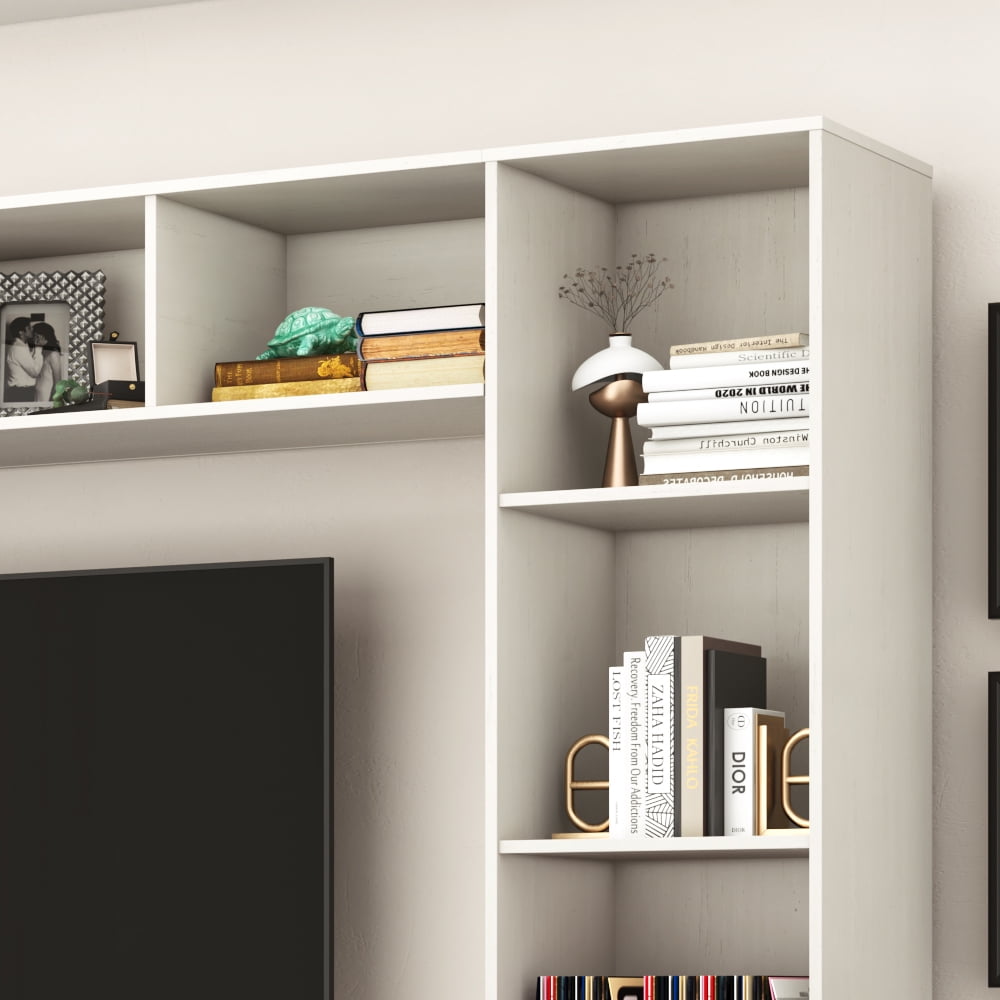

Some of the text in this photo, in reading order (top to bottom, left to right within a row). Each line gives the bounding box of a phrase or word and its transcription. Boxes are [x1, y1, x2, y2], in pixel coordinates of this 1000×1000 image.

[738, 350, 797, 361] Scientific
[749, 370, 770, 378] BOOK
[715, 388, 743, 398] 2020
[745, 387, 756, 396] IN
[759, 385, 797, 395] WORLD
[612, 672, 621, 751] LOST FISH
[631, 703, 642, 741] Freedom
[652, 685, 664, 785] ZAHA HADID
[686, 686, 698, 790] FRIDA KAHLO
[631, 744, 641, 766] From
[631, 768, 641, 785] Our
[732, 752, 746, 794] DIOR
[631, 788, 641, 834] Addictions
